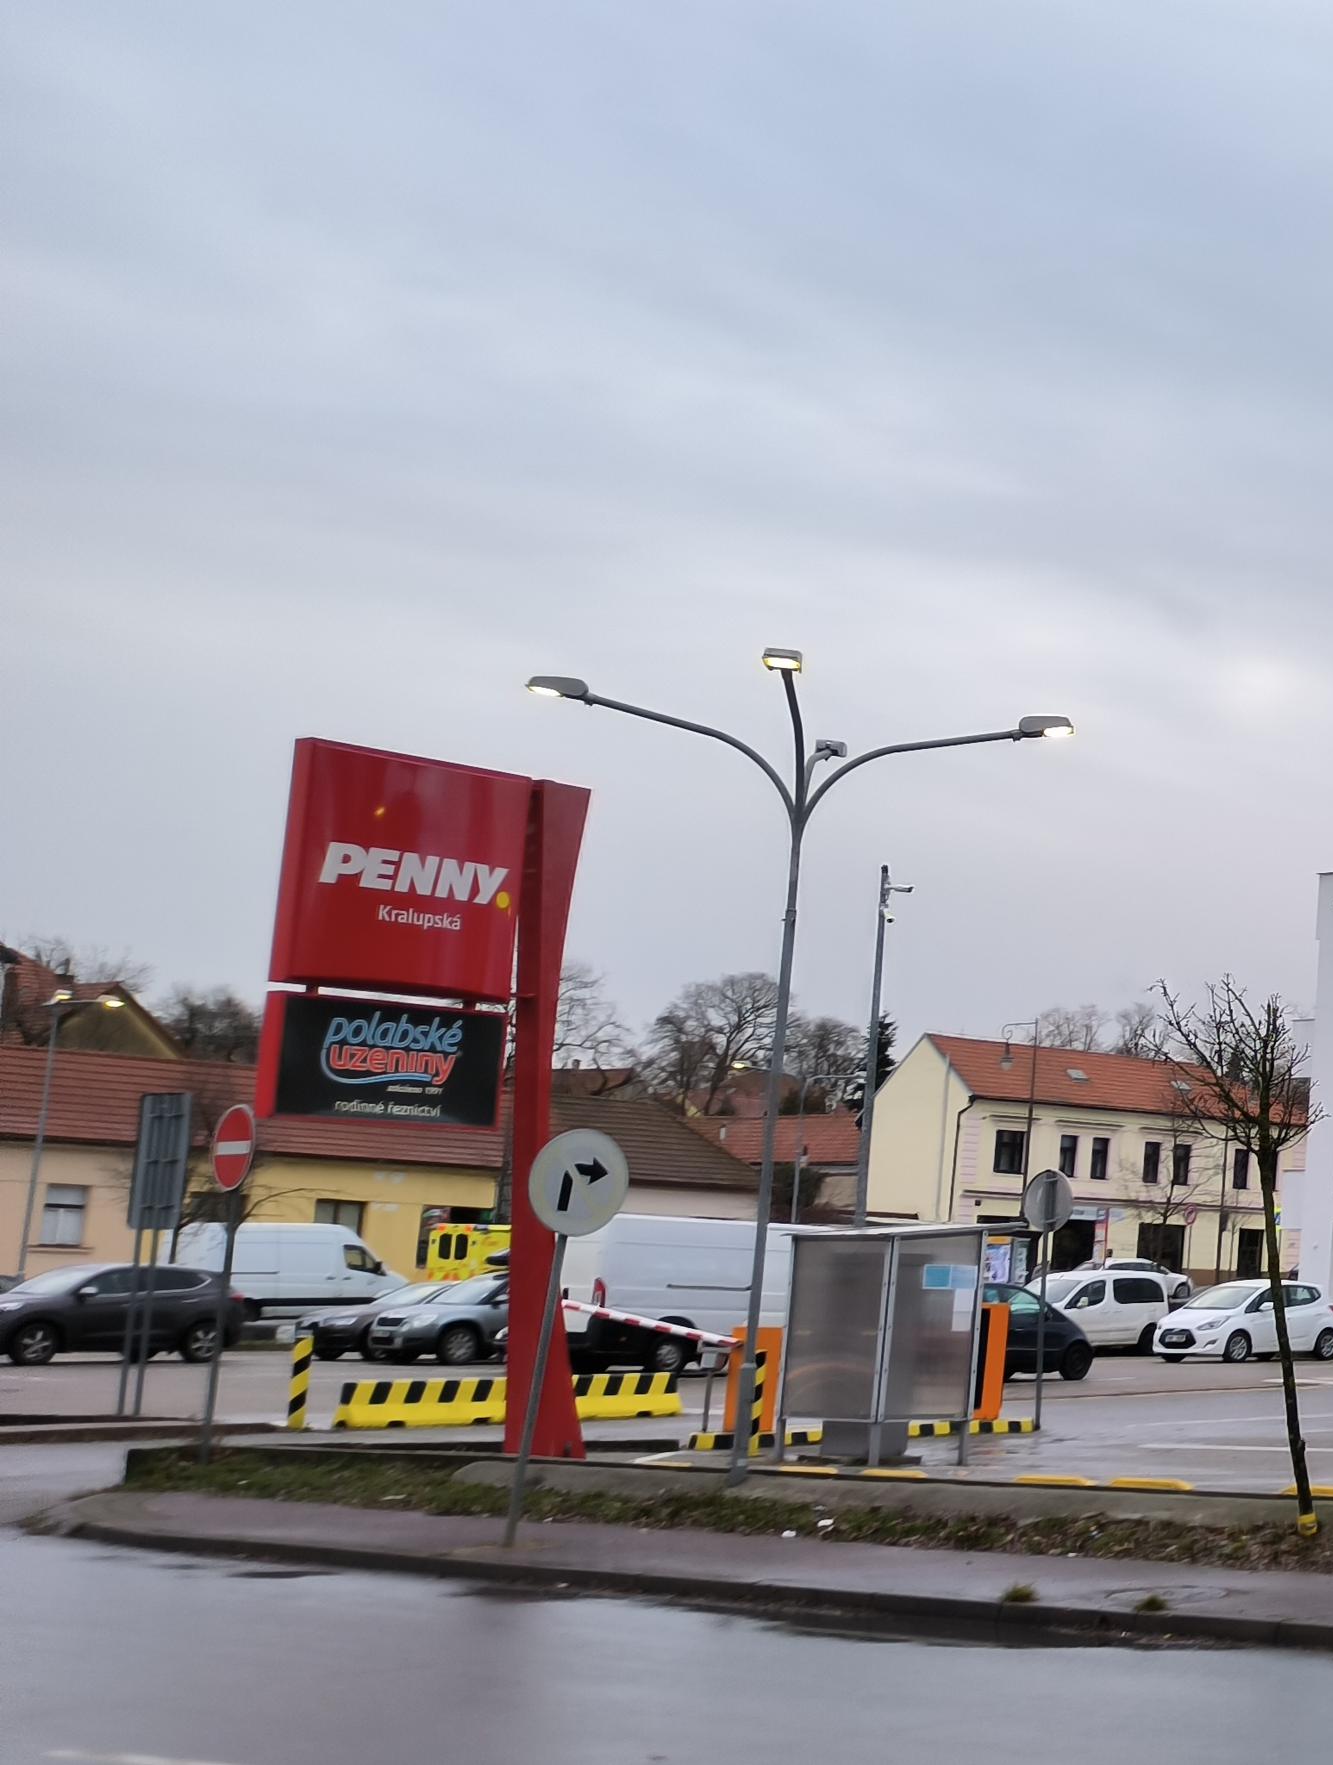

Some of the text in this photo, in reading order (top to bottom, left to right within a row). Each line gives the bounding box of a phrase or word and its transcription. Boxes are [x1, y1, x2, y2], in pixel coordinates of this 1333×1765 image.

[318, 841, 511, 909] PENNY.
[378, 904, 462, 931] Kralupská
[324, 1010, 464, 1053] polabské
[329, 1045, 457, 1085] uzeniny
[334, 1100, 443, 1117] rodinné řeznictví
